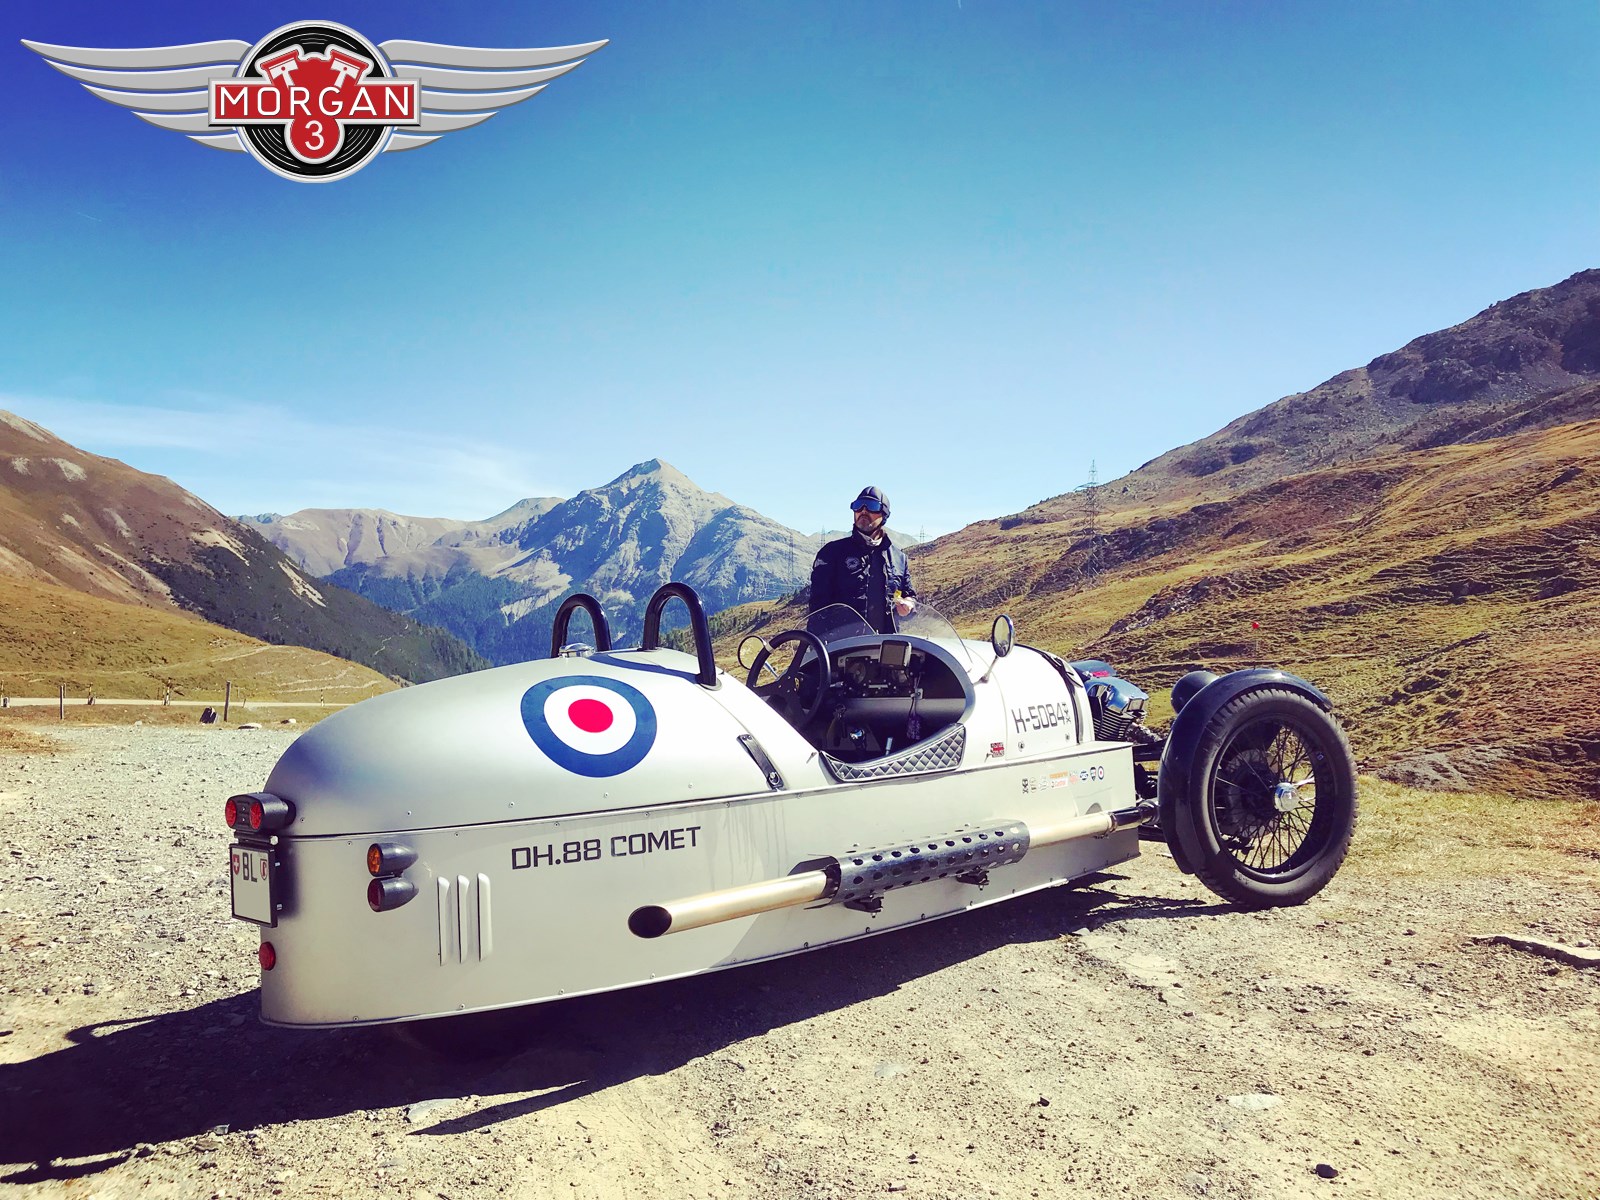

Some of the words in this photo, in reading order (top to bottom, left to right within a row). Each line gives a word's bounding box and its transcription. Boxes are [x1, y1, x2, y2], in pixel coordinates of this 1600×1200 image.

[511, 838, 602, 870] DH.88
[610, 826, 702, 857] COMET
[242, 853, 258, 882] BL
